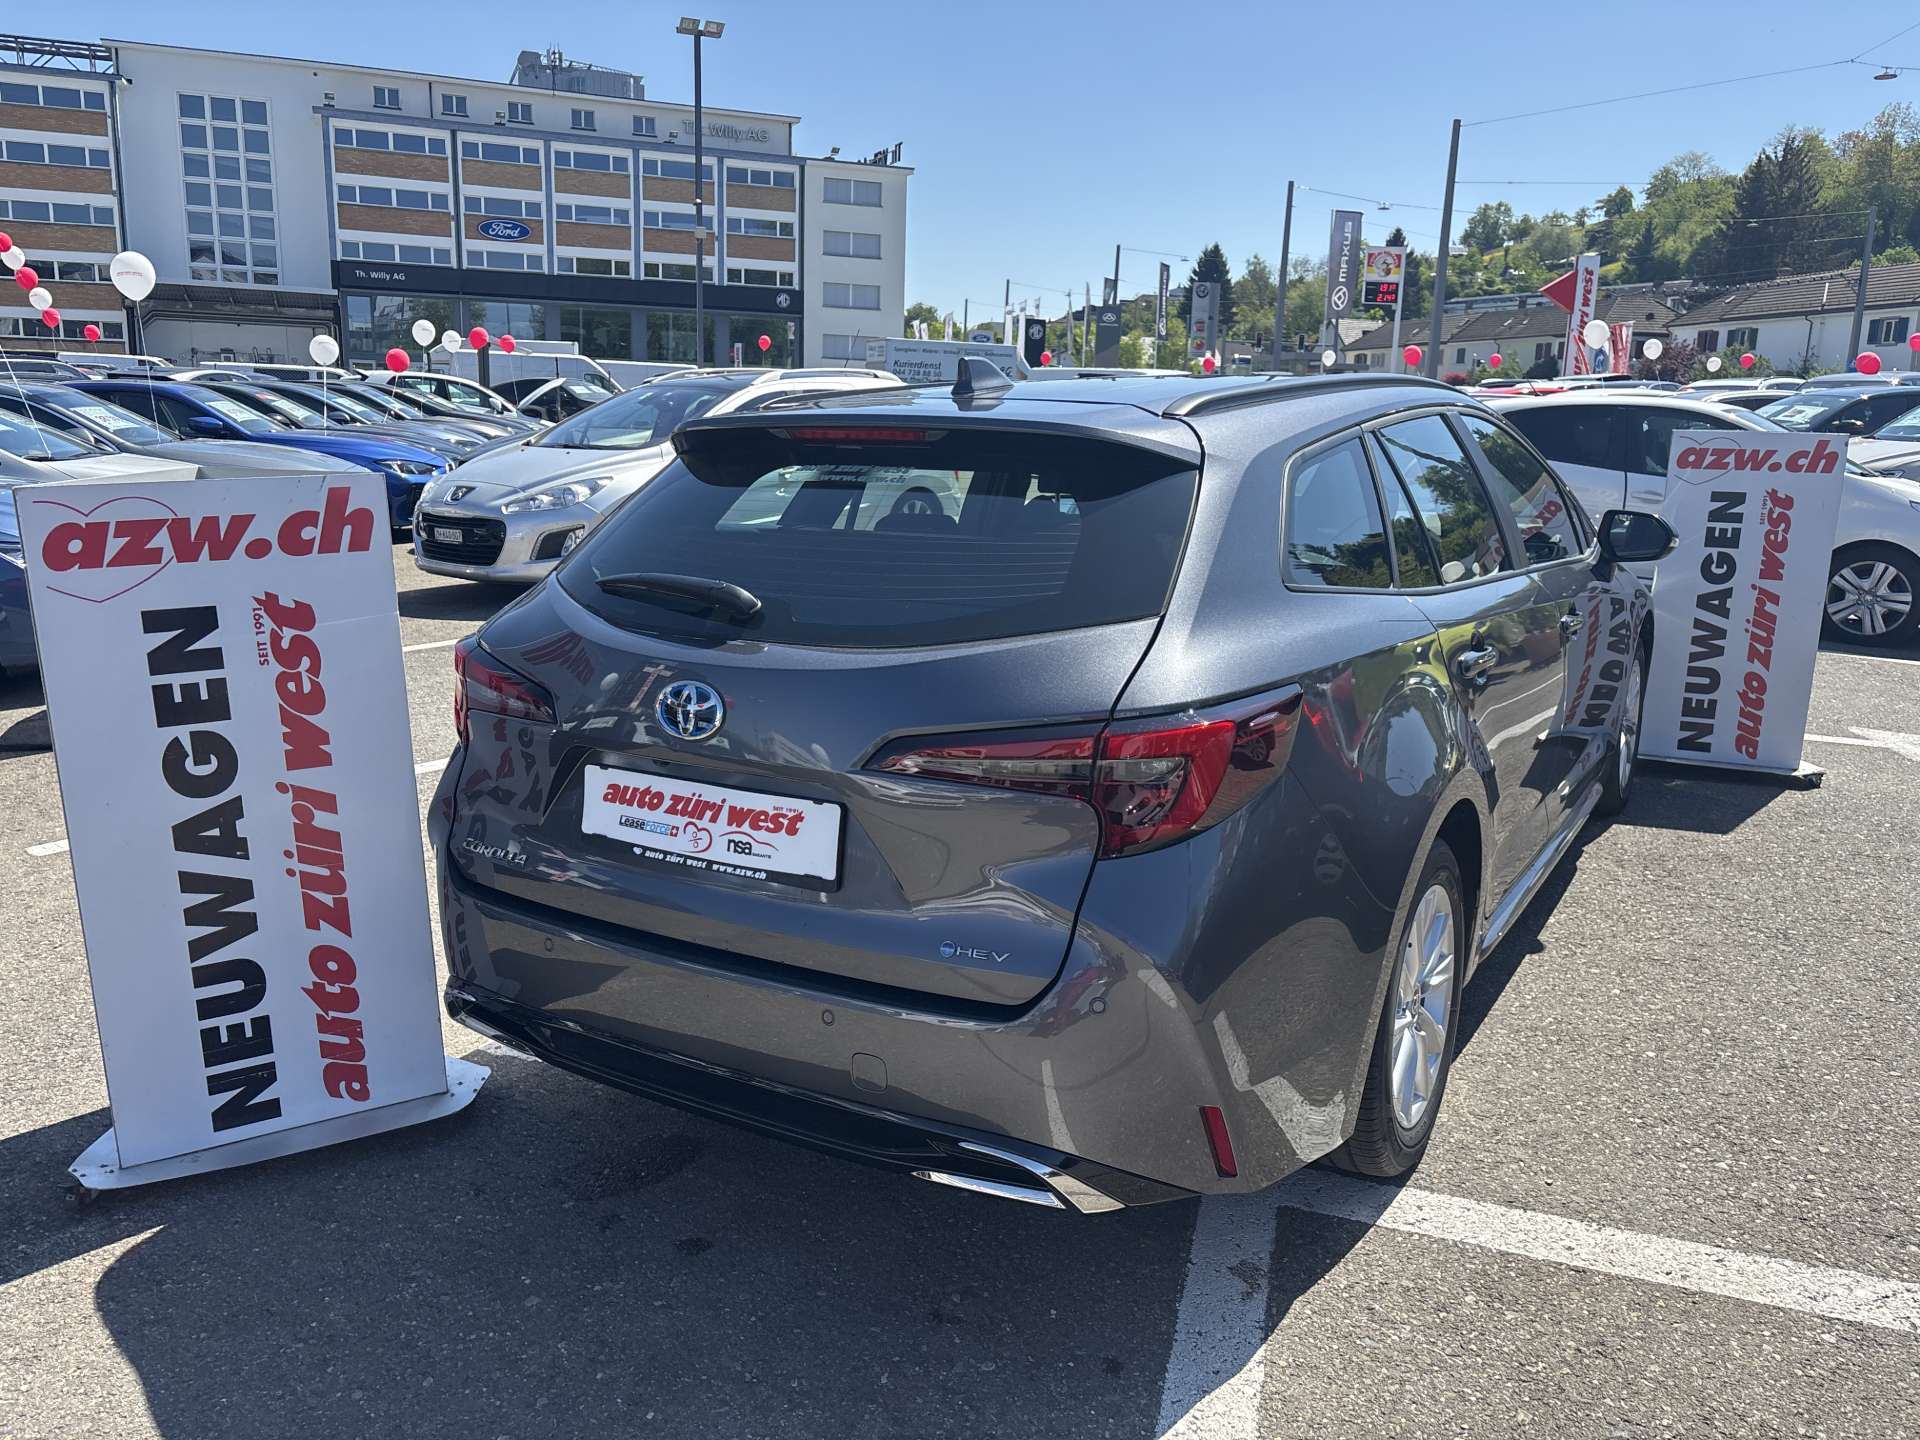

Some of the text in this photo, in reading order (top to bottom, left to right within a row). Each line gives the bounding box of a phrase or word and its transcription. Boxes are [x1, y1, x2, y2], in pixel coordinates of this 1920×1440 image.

[709, 122, 743, 142] Willy
[747, 127, 769, 142] AG
[488, 222, 520, 237] Ford
[1338, 221, 1352, 282] MAXUS
[354, 270, 406, 281] Th. Willy AG
[893, 360, 942, 370] Kurierdienst
[1676, 440, 1840, 474] azw.ch
[42, 487, 376, 573] azw.ch
[252, 607, 269, 666] SEIT 1991
[1676, 490, 1748, 753] NEUWAGEN
[1735, 488, 1794, 760] auto züri west
[603, 783, 805, 836] auto züri west
[619, 815, 671, 836] LeaseForce
[252, 591, 370, 1102] auto züri west
[727, 839, 753, 856] nsa
[141, 605, 282, 1133] NEUWAGEN
[645, 850, 767, 880] auto züri west www.azw.ch
[956, 946, 1011, 962] HEV
